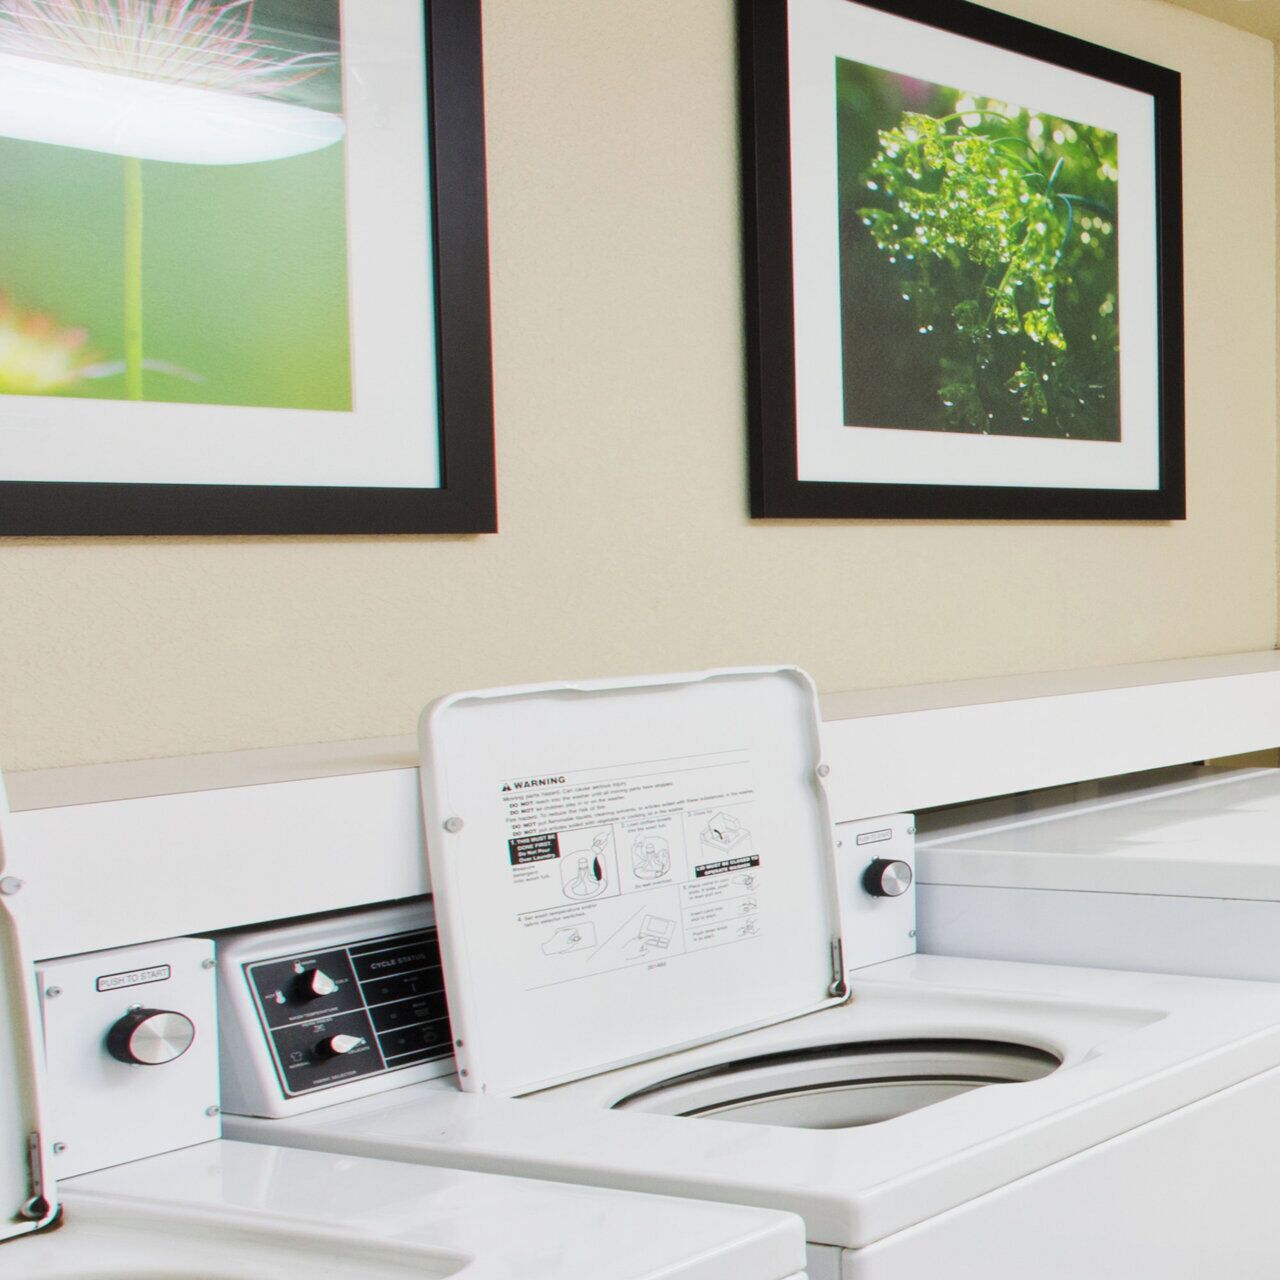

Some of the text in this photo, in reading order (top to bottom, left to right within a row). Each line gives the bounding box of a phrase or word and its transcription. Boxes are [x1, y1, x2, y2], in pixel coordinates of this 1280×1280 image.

[514, 776, 566, 790] WARNING
[370, 953, 426, 970] CYCLE STATUS
